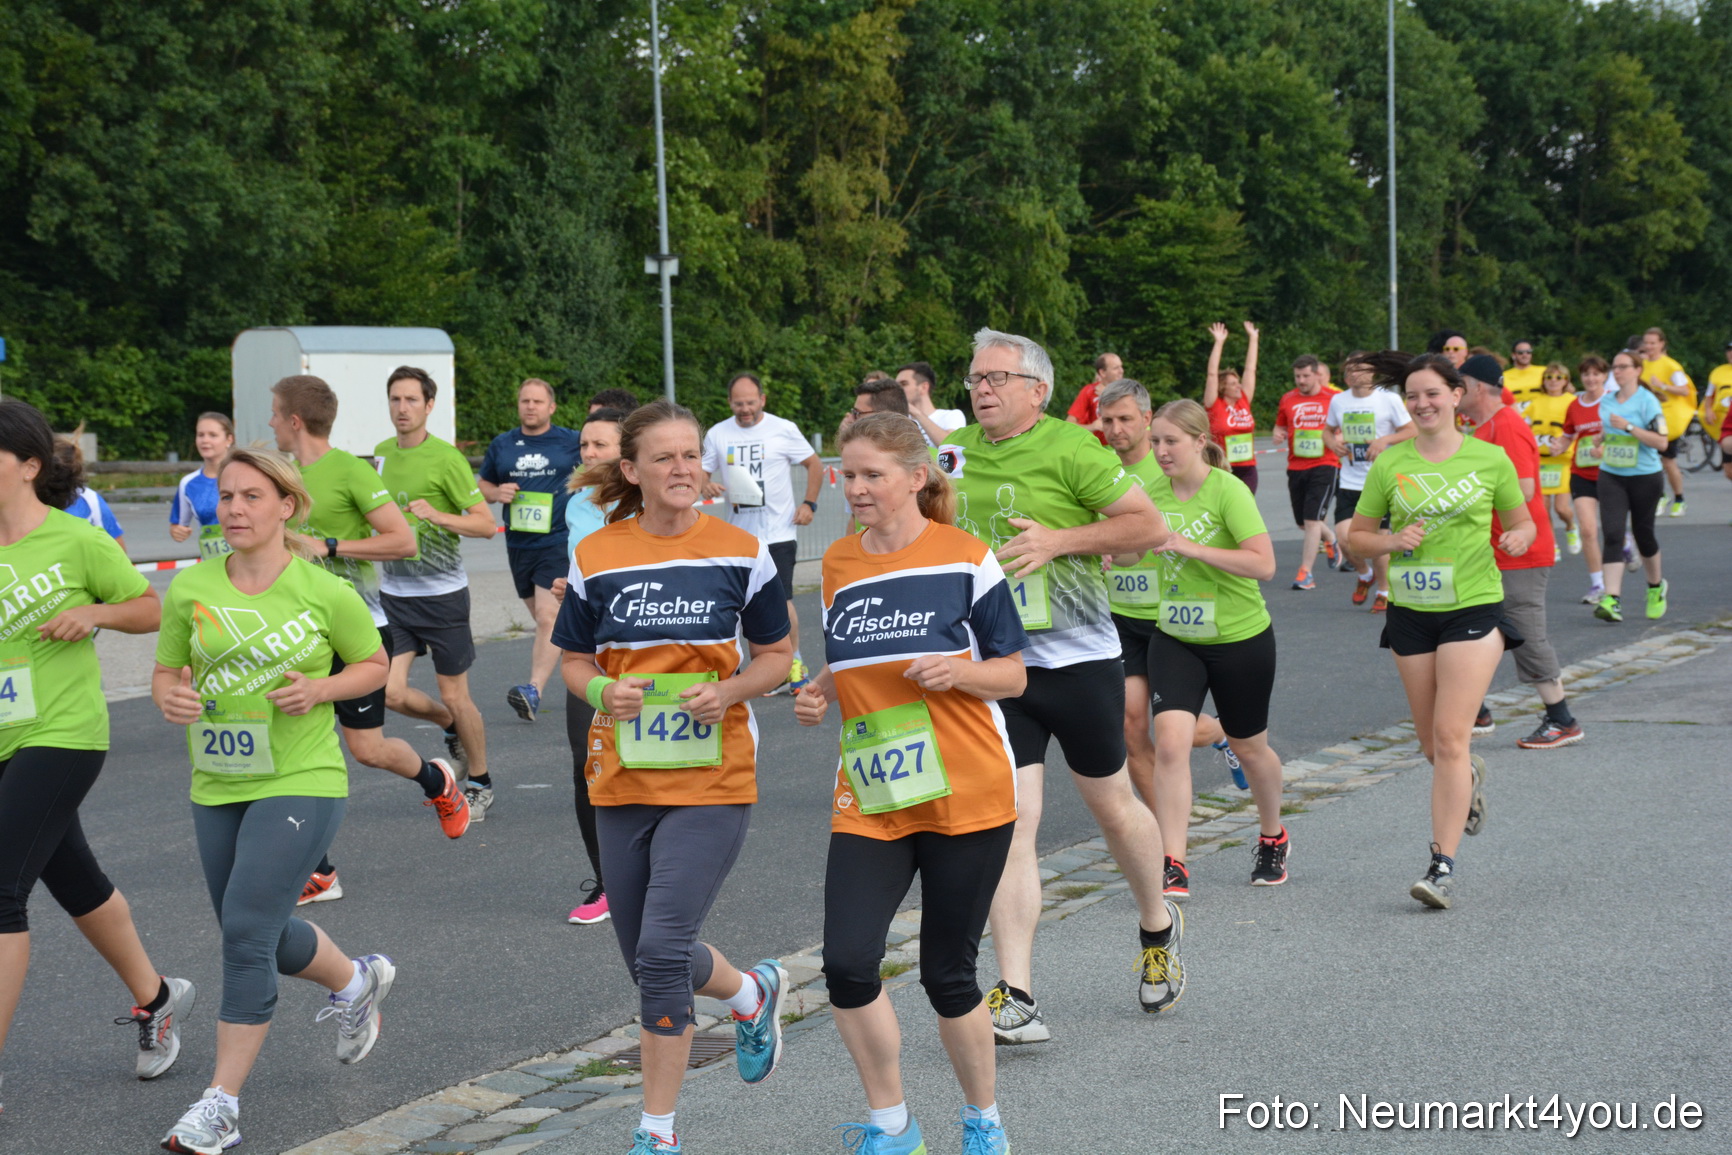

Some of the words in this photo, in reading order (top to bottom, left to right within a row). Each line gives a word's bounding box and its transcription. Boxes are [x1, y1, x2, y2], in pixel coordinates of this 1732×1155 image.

[1345, 425, 1372, 435] 1164
[1299, 441, 1317, 450] 421
[517, 507, 542, 521] 176
[204, 539, 234, 554] 113
[1114, 575, 1148, 592] 208
[1401, 571, 1442, 590] 195
[626, 596, 715, 617] Fischer
[1168, 606, 1204, 625] 202
[634, 616, 709, 627] AUTOMOBILE
[846, 609, 935, 635] Fischer
[853, 628, 927, 644] AUTOMOBILE
[628, 712, 712, 741] 1426
[202, 729, 254, 756] 209
[853, 740, 926, 787] 1427
